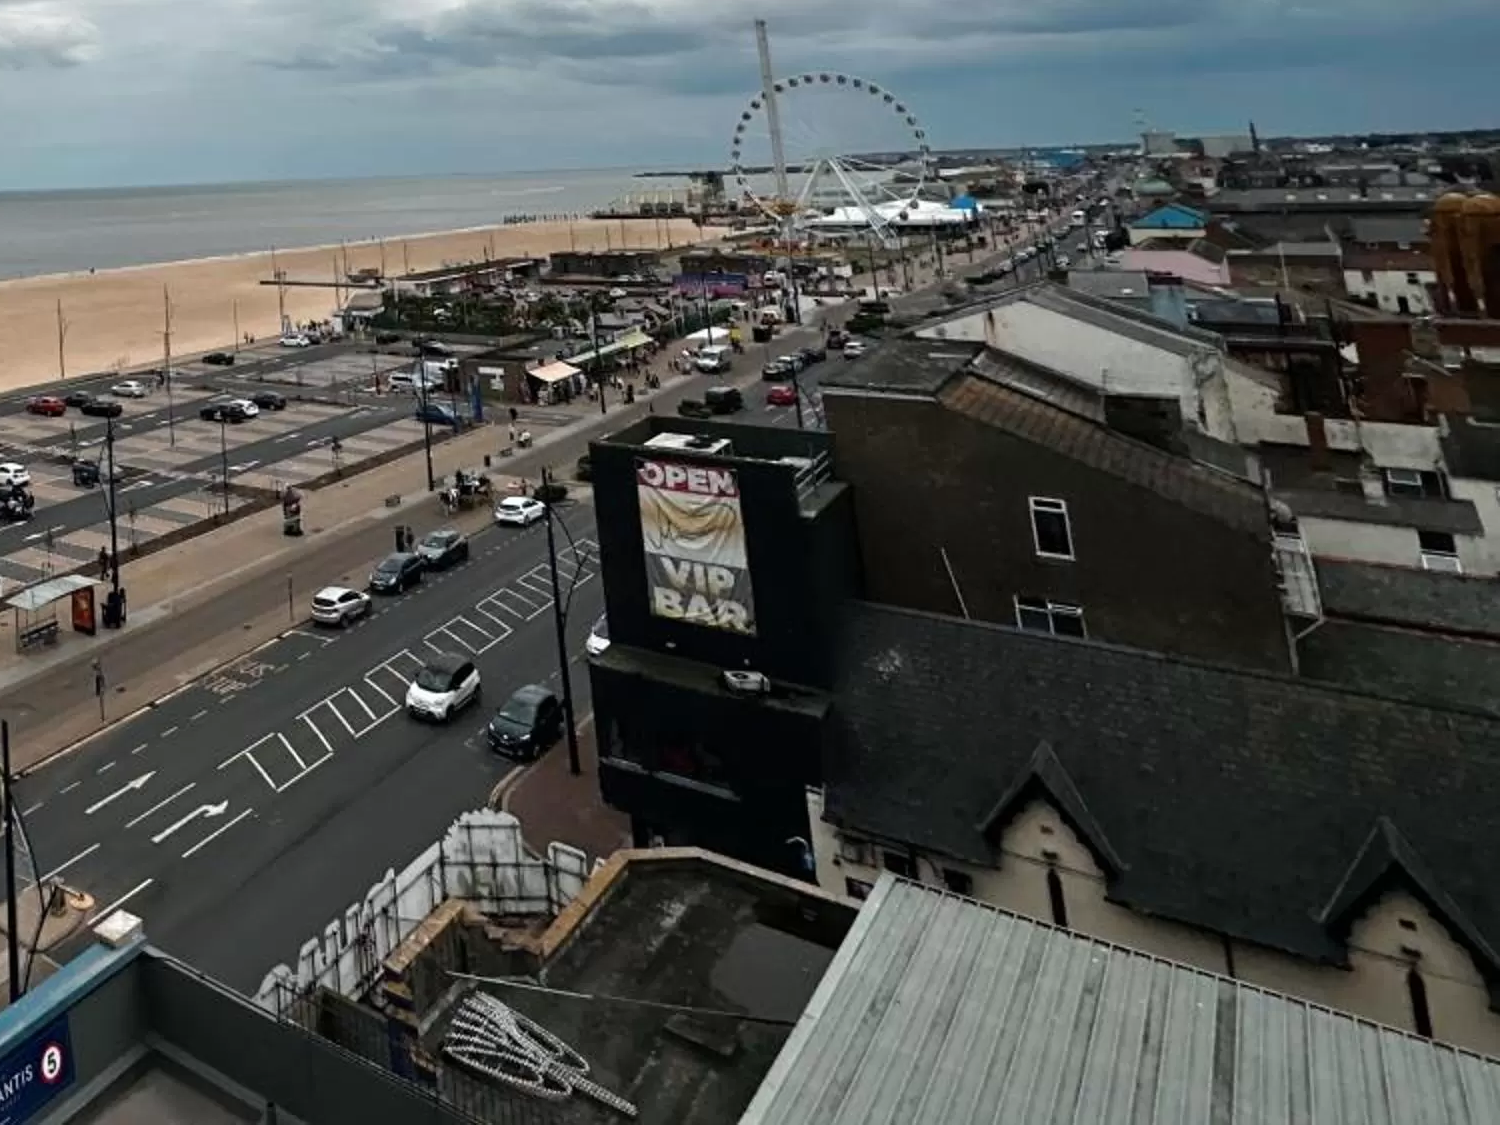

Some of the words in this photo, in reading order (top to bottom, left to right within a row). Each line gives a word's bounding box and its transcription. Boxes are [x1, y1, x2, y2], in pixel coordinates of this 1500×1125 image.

[638, 462, 735, 494] OPEN
[660, 556, 735, 594] VIP
[654, 586, 753, 634] BAR
[46, 1051, 57, 1075] 5
